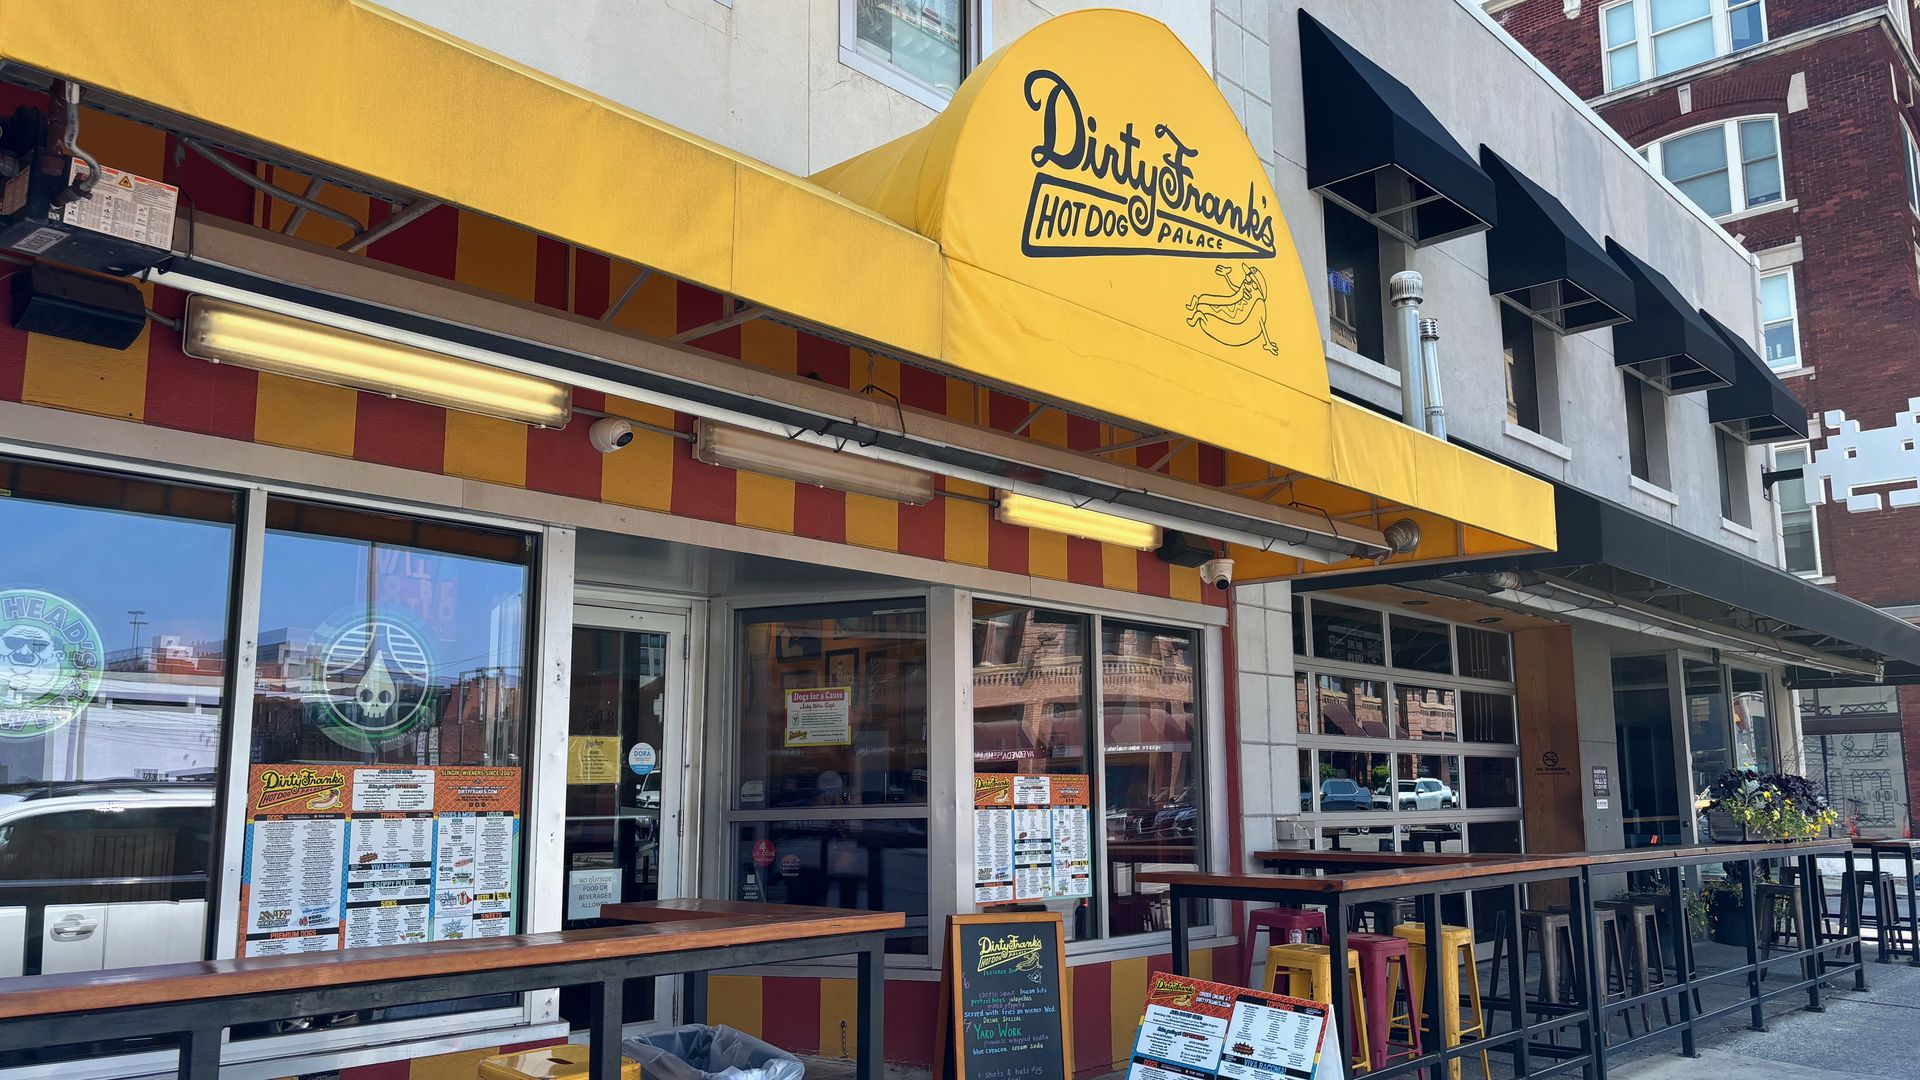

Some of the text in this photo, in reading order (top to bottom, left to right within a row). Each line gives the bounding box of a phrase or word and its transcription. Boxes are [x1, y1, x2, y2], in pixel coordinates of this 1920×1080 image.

[1024, 69, 1275, 247] Dirty Frank's
[1157, 222, 1224, 250] PALACE
[794, 692, 810, 702] Dogs
[810, 692, 821, 700] for
[825, 691, 844, 700] Cause
[262, 771, 302, 795] Dirty
[301, 769, 345, 787] Frank's
[397, 879, 416, 887] PLATES
[578, 893, 612, 901] BEVERAGES
[381, 899, 398, 908] SIDES
[271, 929, 317, 939] PREMIUM DOGS
[978, 934, 1042, 959] Dirty Frank's
[1266, 1000, 1295, 1012] TOPPINGS
[964, 1010, 983, 1018] served
[997, 1022, 1022, 1037] WORK
[1244, 1058, 1258, 1068] VIVA
